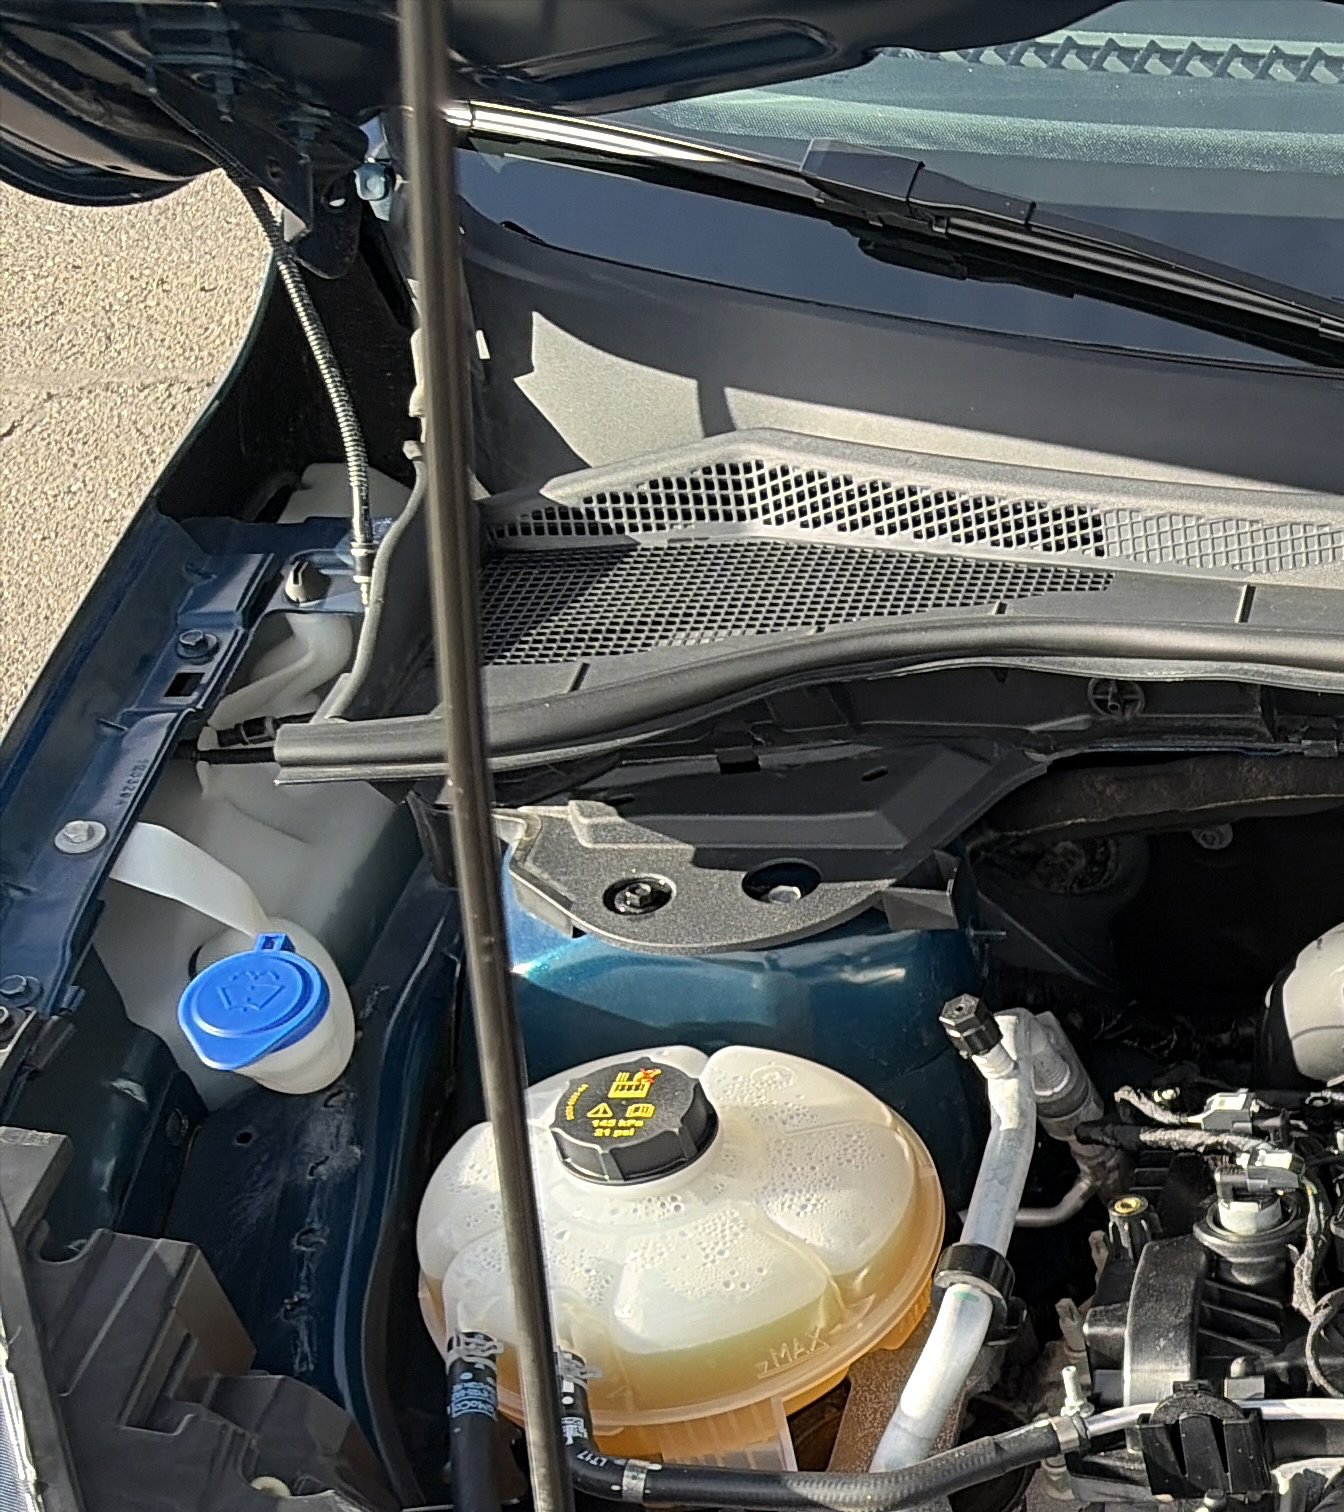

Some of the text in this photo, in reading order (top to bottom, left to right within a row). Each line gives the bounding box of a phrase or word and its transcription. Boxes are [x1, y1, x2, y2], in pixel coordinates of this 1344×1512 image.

[618, 1119, 644, 1127] kPa
[594, 1128, 635, 1137] 21 psi
